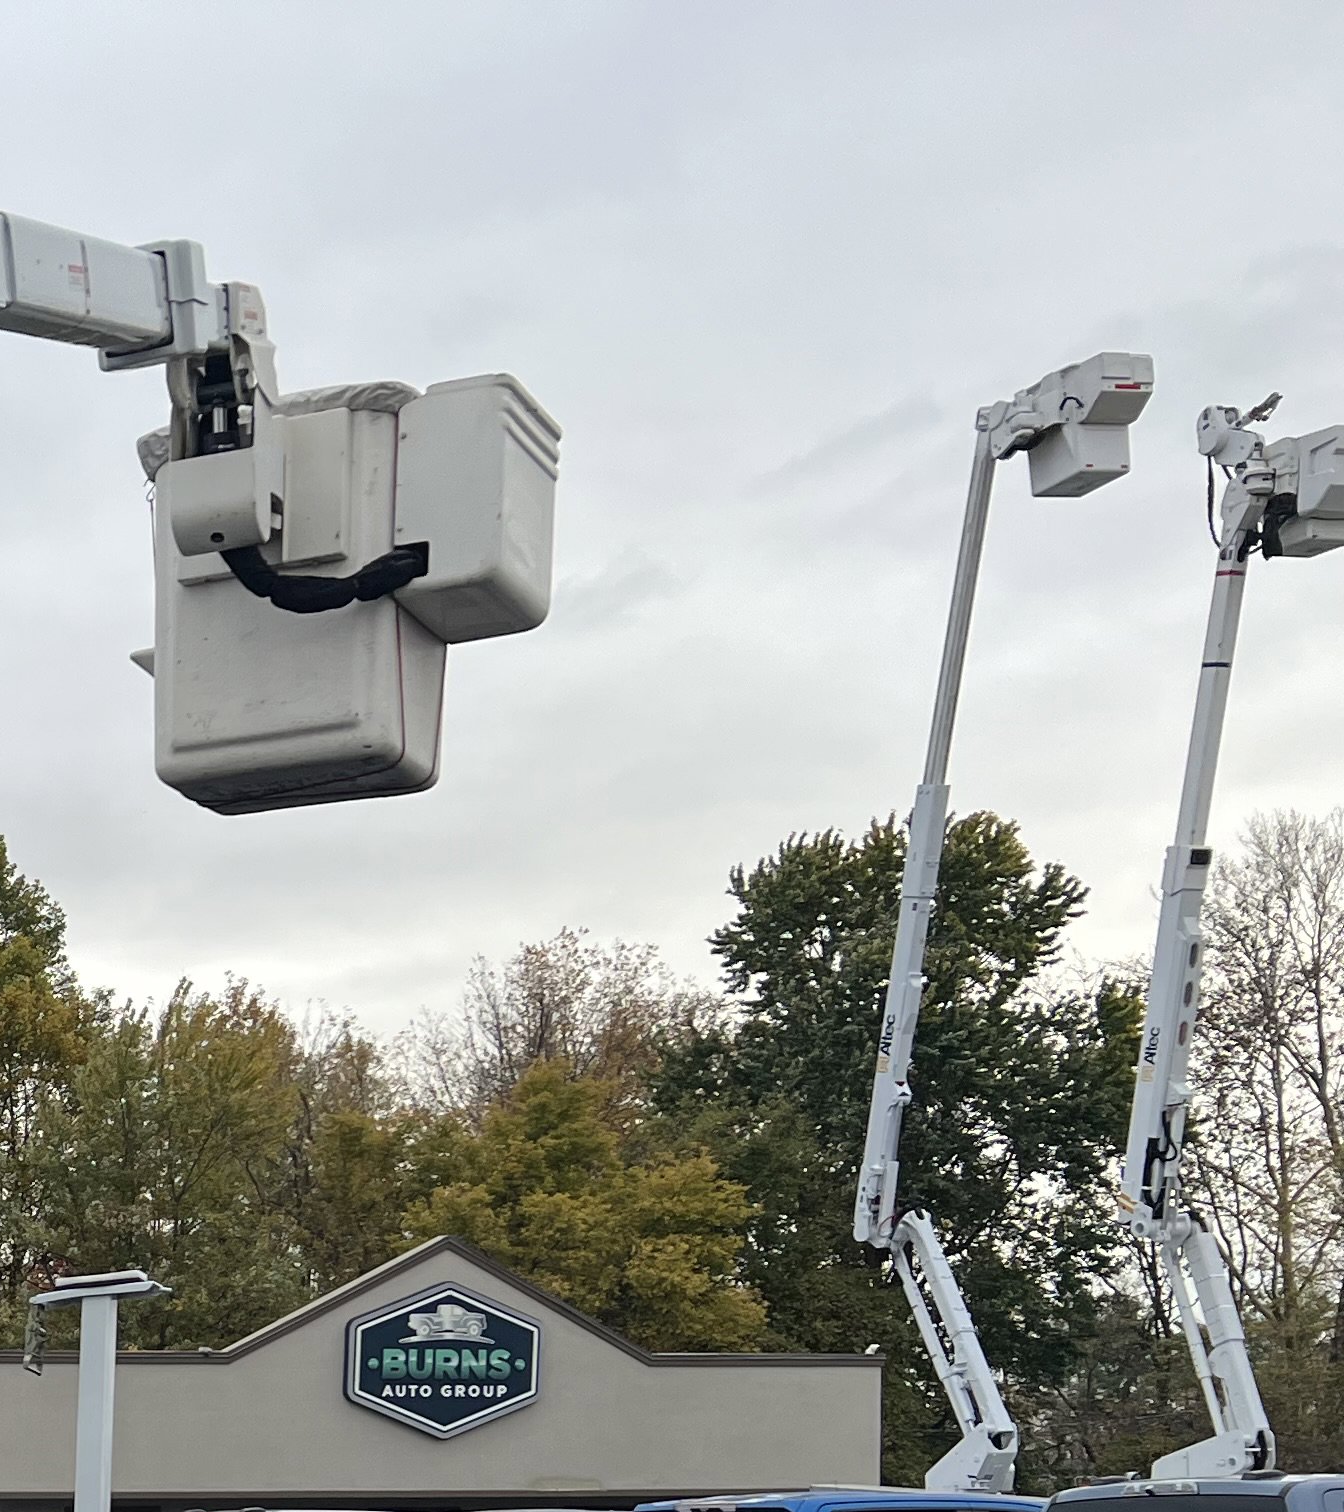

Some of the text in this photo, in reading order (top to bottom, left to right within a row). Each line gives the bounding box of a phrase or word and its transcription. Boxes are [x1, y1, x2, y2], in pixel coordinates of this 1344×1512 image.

[880, 1014, 896, 1056] Altec
[1143, 1027, 1160, 1065] Altec
[381, 1348, 512, 1380] BURNS
[381, 1384, 508, 1398] AUTO GROUP
